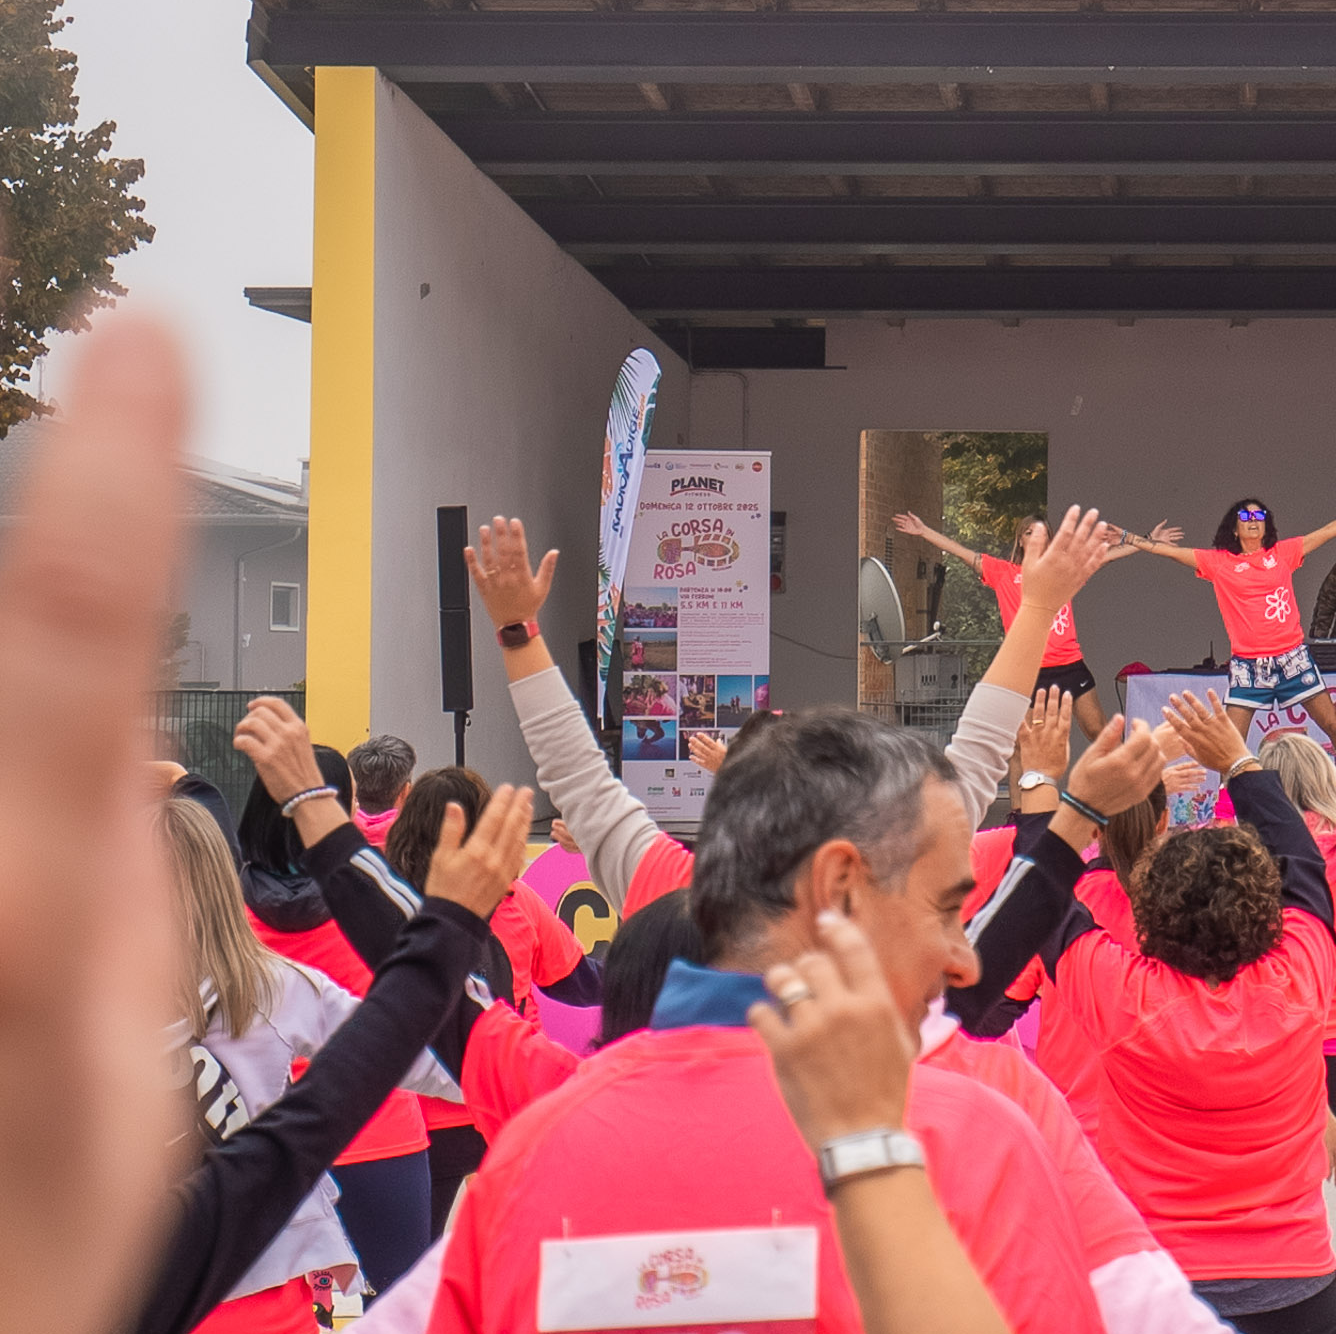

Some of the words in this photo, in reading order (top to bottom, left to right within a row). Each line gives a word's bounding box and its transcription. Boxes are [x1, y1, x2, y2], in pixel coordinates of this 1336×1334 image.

[671, 476, 725, 492] PLANET
[639, 501, 682, 512] DOMENICA
[685, 502, 694, 511] 12
[697, 502, 734, 512] OTTOBRE
[736, 502, 760, 512] 2025
[656, 530, 669, 541] LA
[671, 517, 724, 538] CORSA
[725, 527, 735, 537] IN
[653, 561, 697, 580] ROSA
[680, 600, 693, 609] 5.5
[696, 600, 710, 610] KM
[730, 600, 744, 610] KM
[1256, 712, 1280, 733] LA
